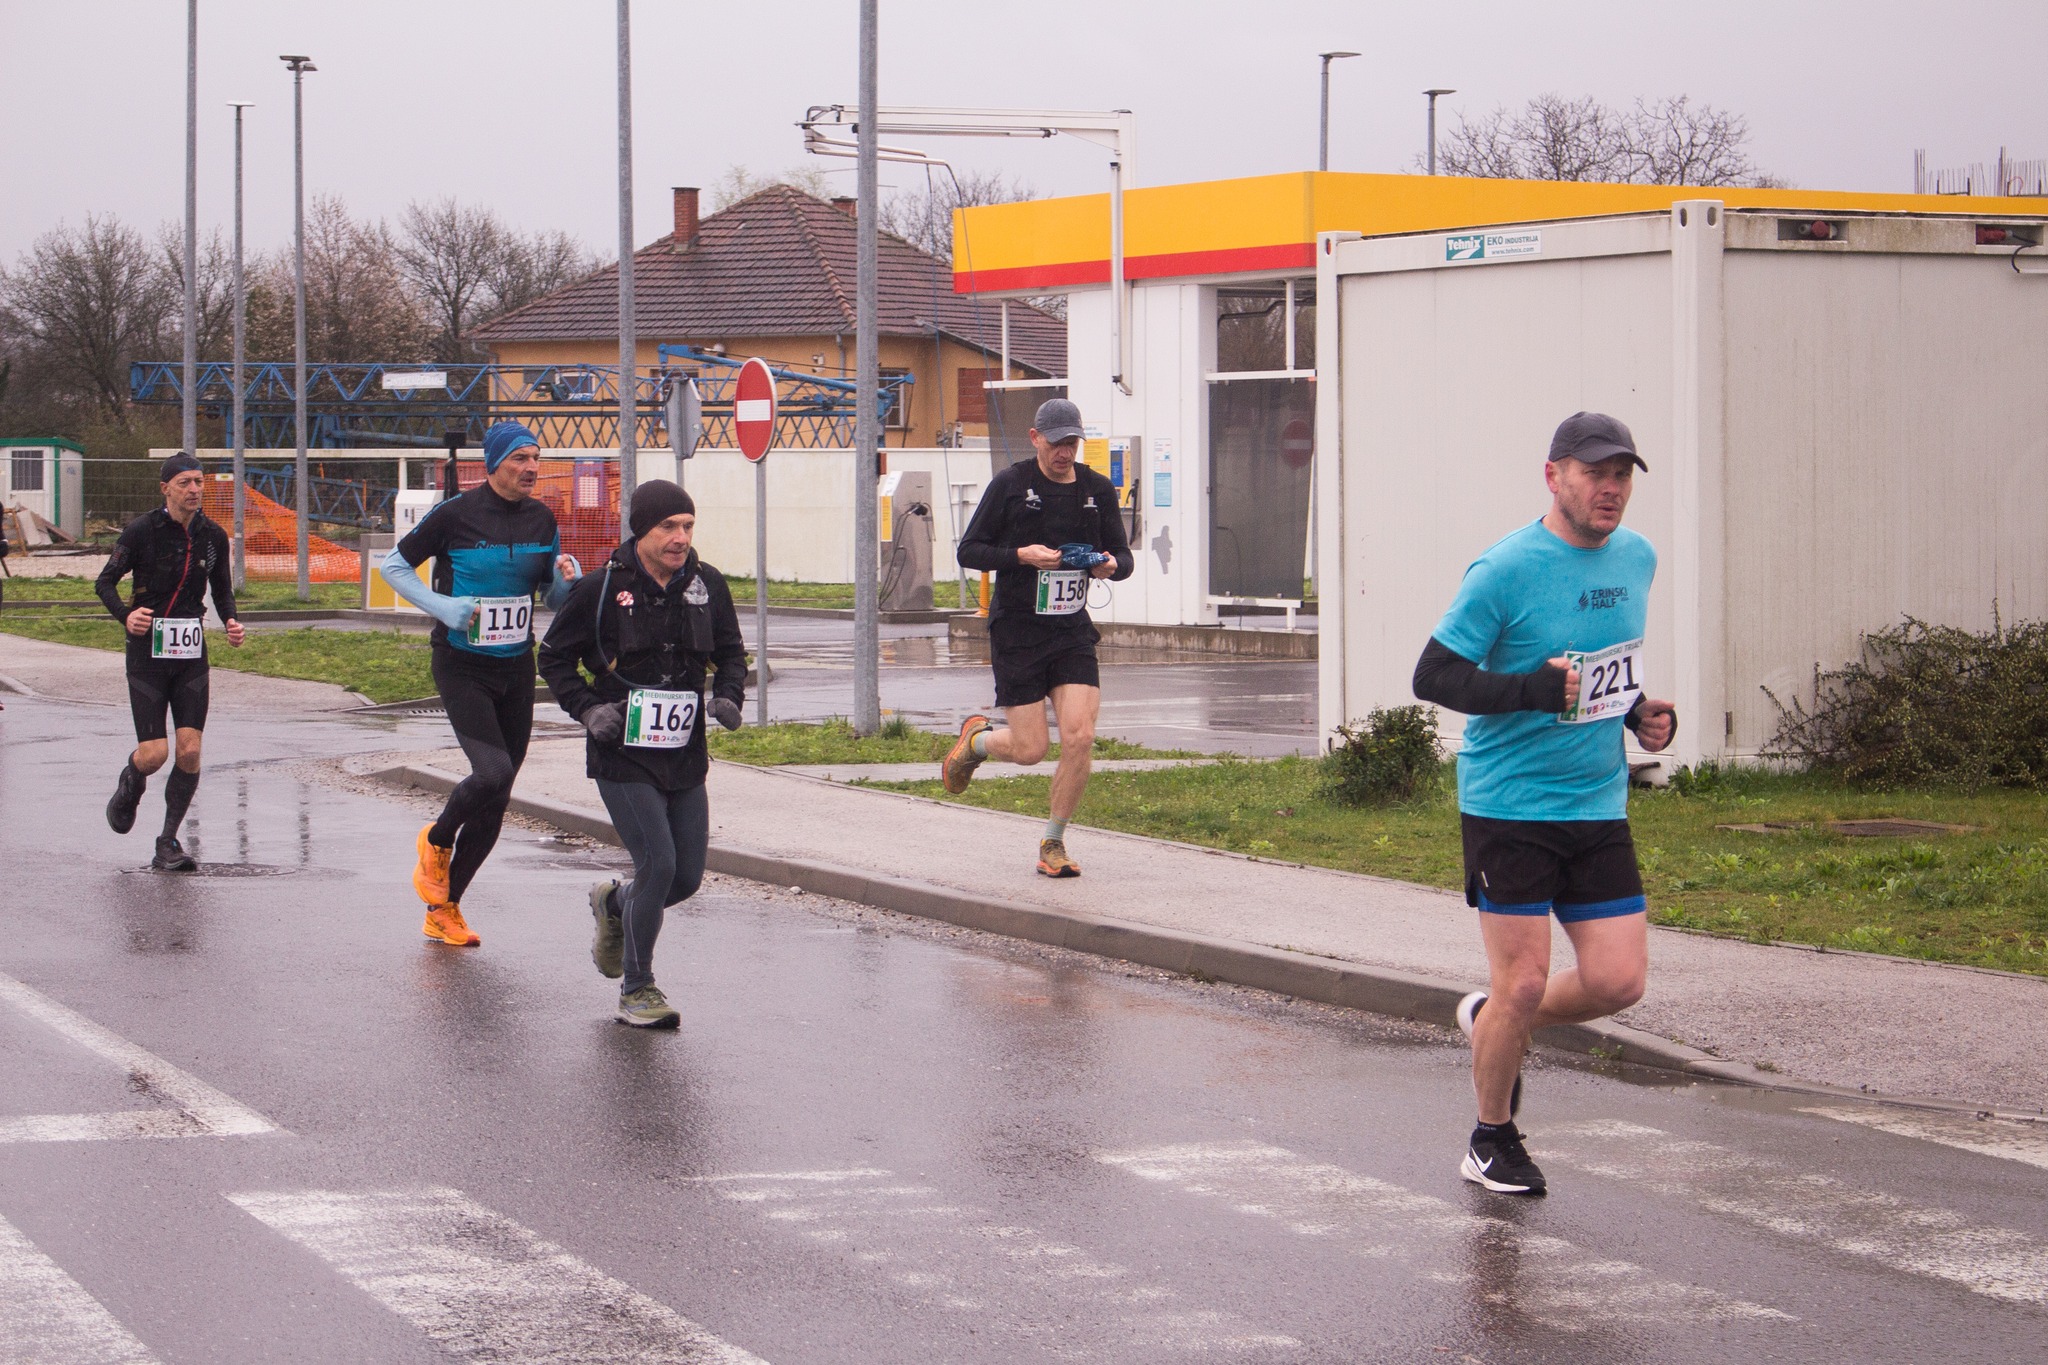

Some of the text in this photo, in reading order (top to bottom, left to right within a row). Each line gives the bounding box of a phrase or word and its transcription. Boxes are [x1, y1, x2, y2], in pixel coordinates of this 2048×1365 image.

[1447, 236, 1481, 251] Tehnix
[1487, 235, 1539, 246] EKO INDUSTRIJA
[1491, 246, 1535, 255] www.tehnix.com
[1054, 579, 1085, 602] 158
[1590, 587, 1628, 600] ZRINSKI
[1591, 597, 1616, 610] HALF
[488, 606, 528, 631] 110
[169, 627, 200, 647] 160
[1589, 656, 1640, 701] 221
[650, 703, 694, 731] 162
